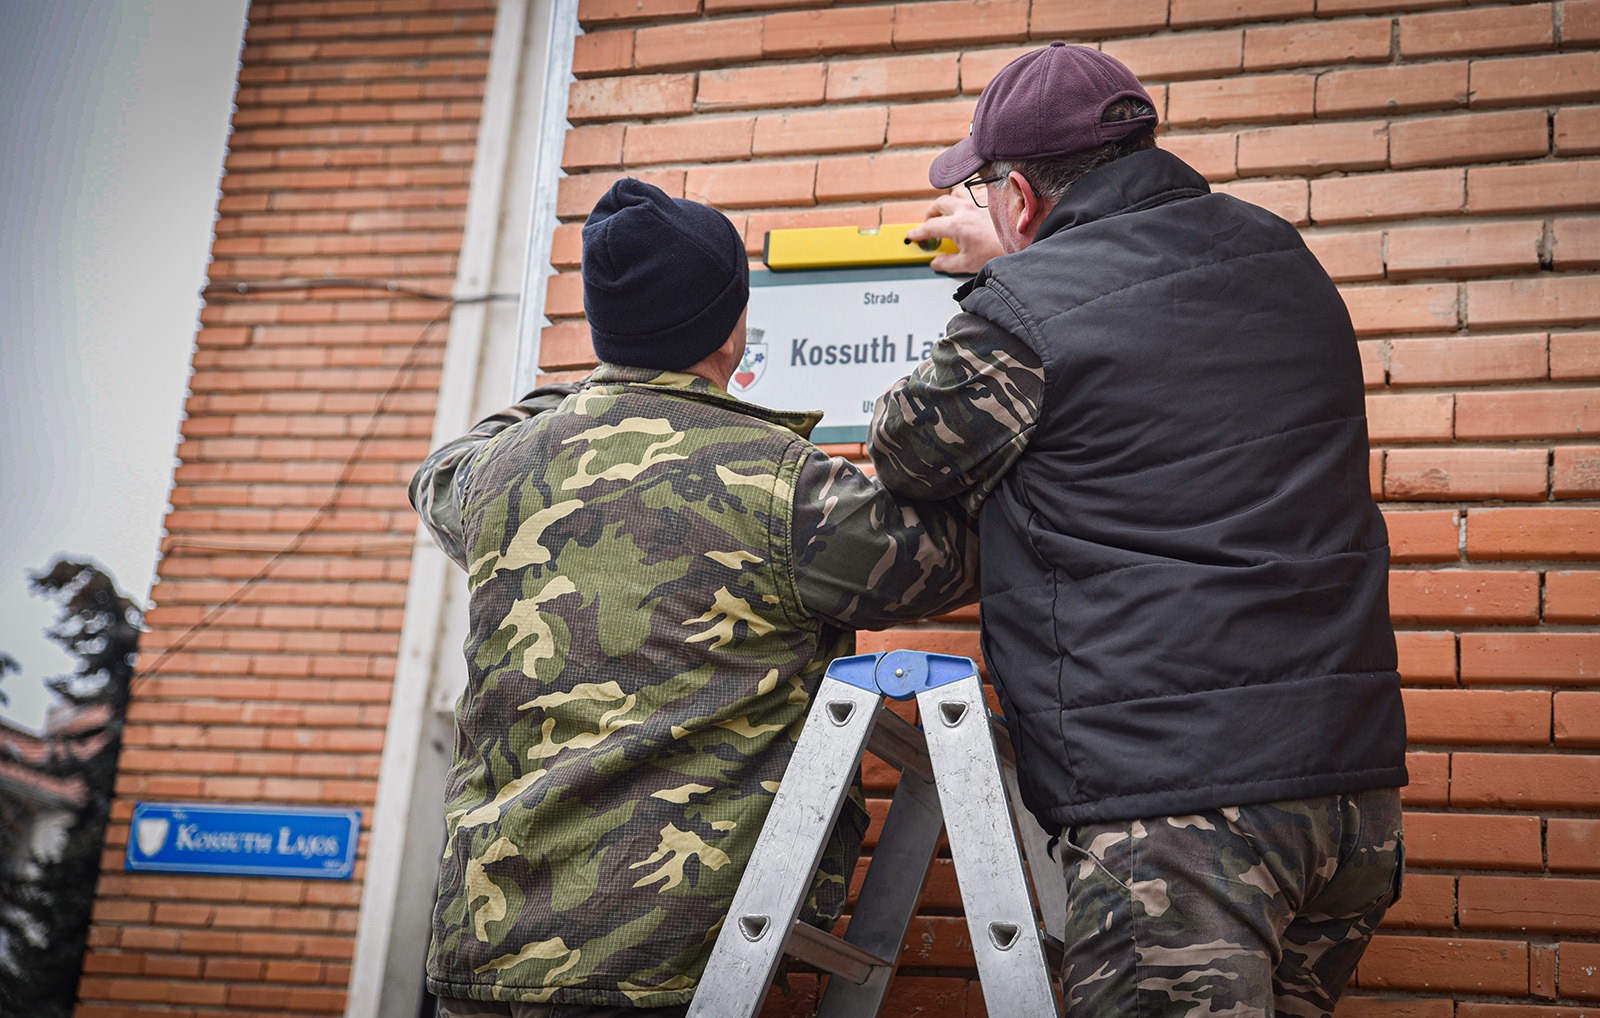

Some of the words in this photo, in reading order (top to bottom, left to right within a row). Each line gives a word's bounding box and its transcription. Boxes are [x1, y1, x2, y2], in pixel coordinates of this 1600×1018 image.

[863, 291, 900, 305] Strada
[790, 335, 896, 367] Kossuth
[906, 333, 944, 362] La
